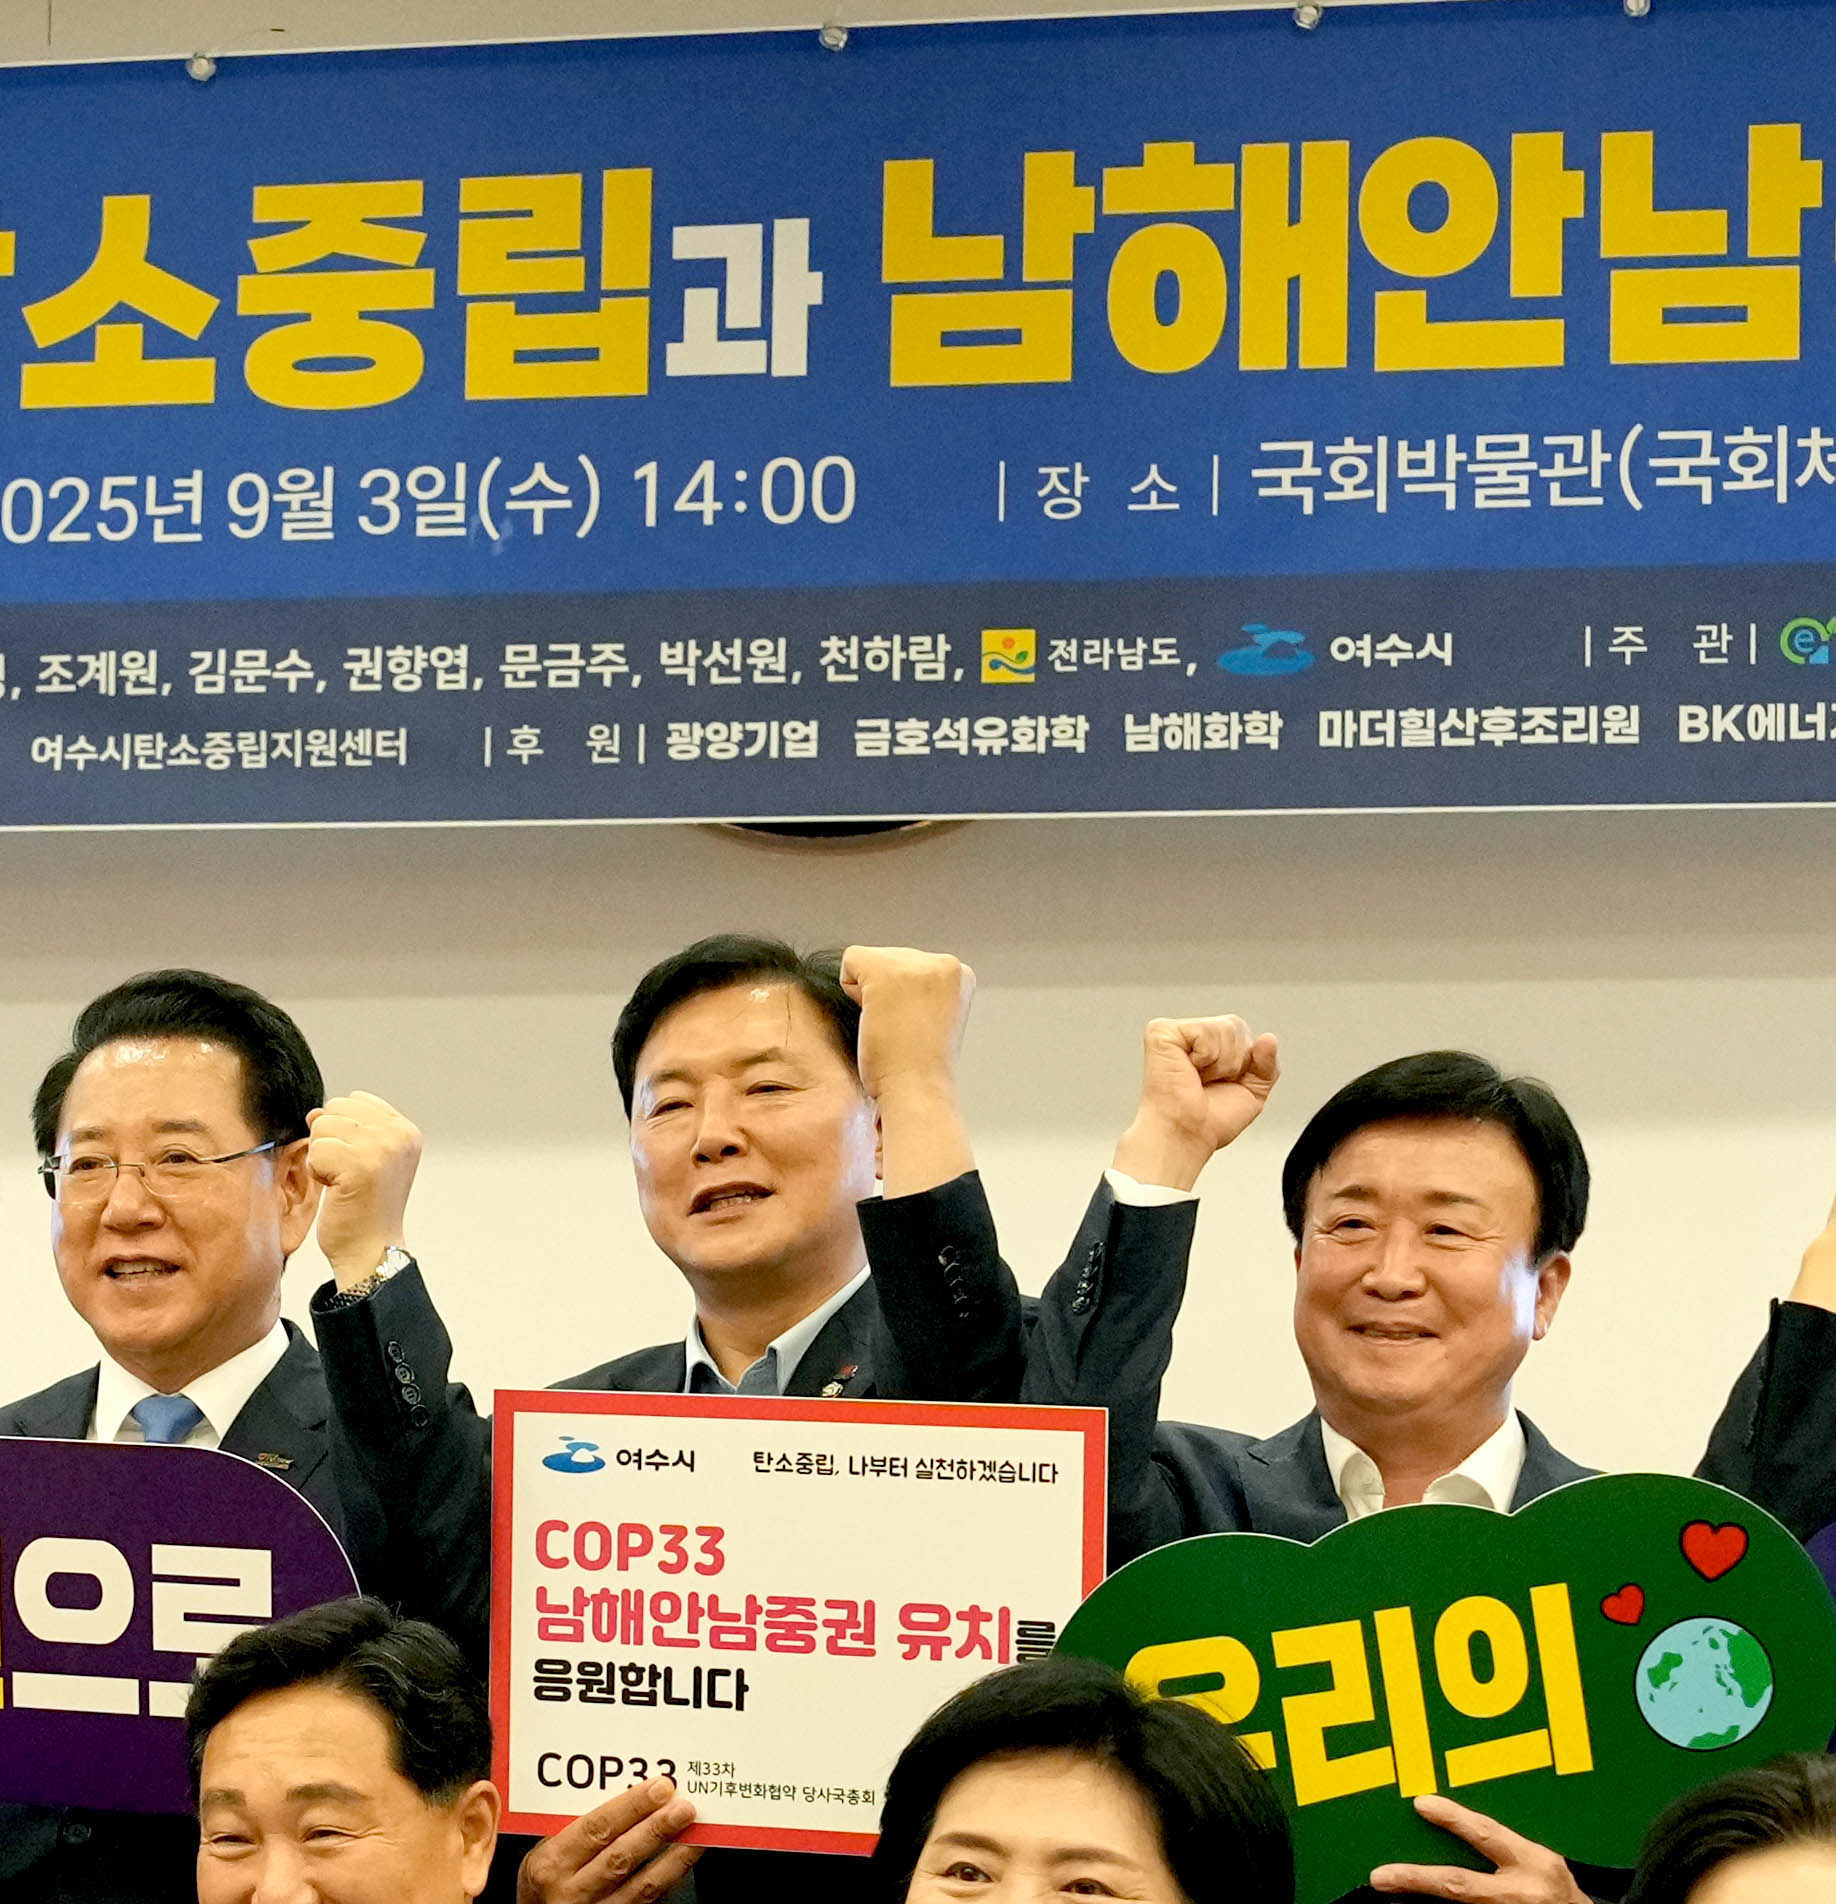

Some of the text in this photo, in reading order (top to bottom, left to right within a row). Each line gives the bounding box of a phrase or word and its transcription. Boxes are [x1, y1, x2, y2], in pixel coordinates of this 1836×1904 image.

[228, 466, 334, 541] 9월
[358, 455, 600, 540] 3일(수)
[634, 456, 855, 527] 14:00
[36, 650, 171, 696] 조계원,
[189, 648, 326, 694] 김문수,
[343, 644, 483, 692] 권향엽,
[499, 643, 641, 688] 문금주,
[660, 637, 801, 686] 박선원,
[820, 634, 963, 682] 천하람,
[1048, 637, 1196, 676] 전라남도,
[1330, 633, 1452, 668] 여수시
[31, 728, 407, 771] 여수시탄소중립지원센터
[666, 720, 818, 760] 광양기업
[854, 715, 1089, 757] 금호석유화학
[1125, 711, 1283, 752] 남해화학
[1319, 705, 1639, 748] 마더힐산후조리원
[616, 1449, 1058, 1484] 여수시 탄소중립, 나부터 실천하겠습니다
[536, 1520, 725, 1576] COP33
[536, 1586, 1055, 1664] 남해안남중권 유치를
[533, 1659, 749, 1711] 응원합니다
